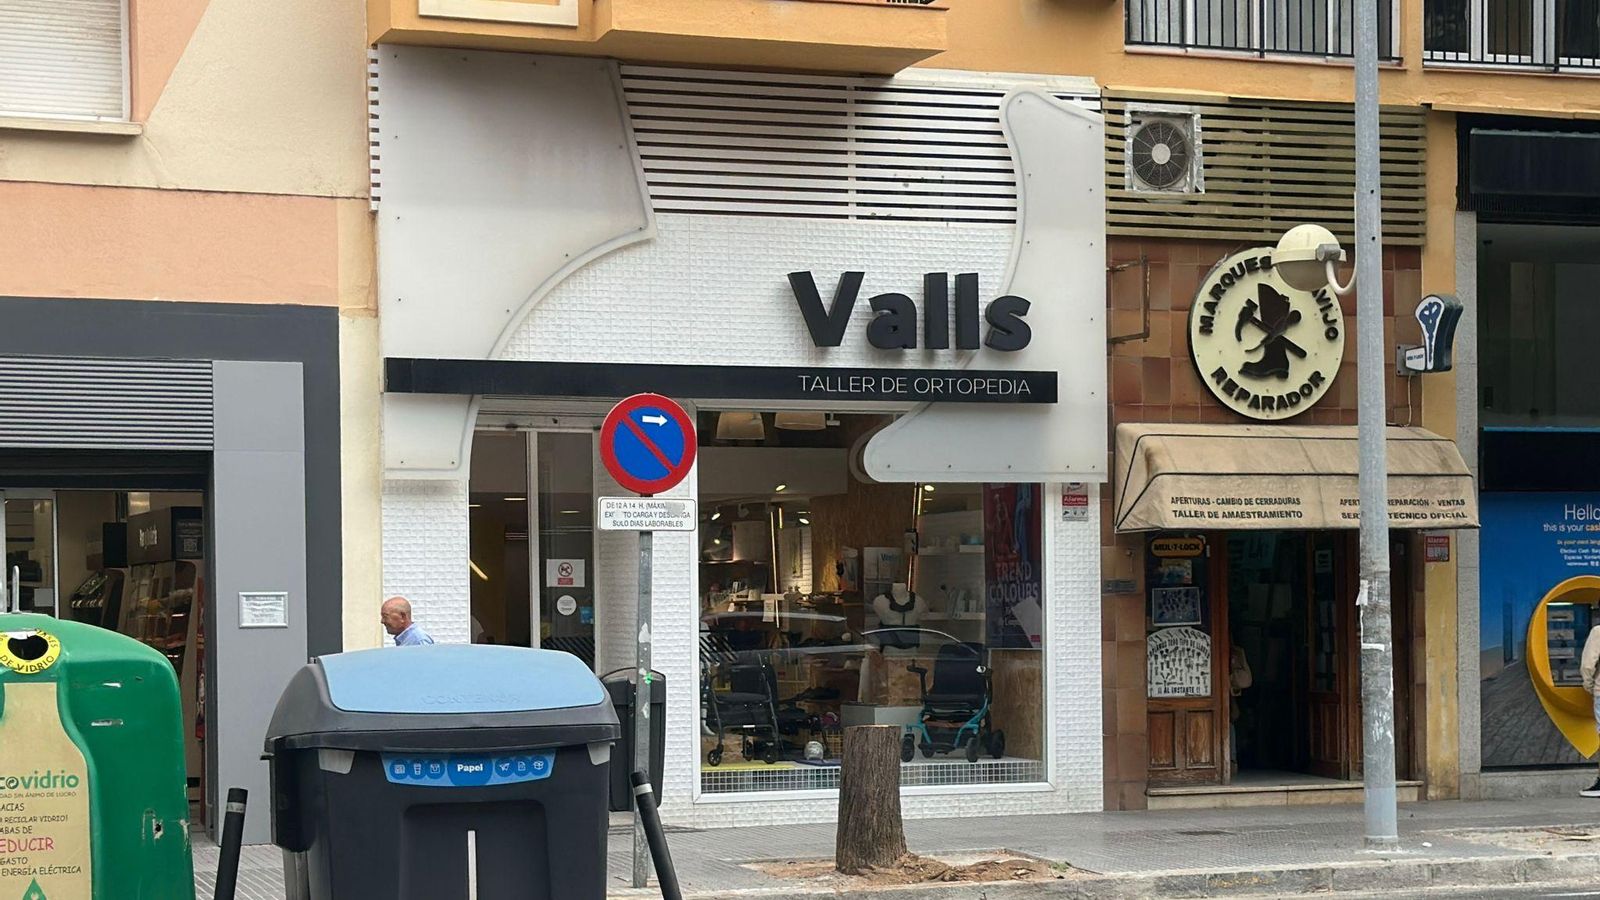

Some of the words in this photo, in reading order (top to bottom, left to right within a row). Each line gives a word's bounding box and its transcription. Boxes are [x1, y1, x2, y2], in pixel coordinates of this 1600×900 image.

[1199, 256, 1273, 336] MARQUES
[1312, 289, 1339, 341] VIJO
[787, 271, 1032, 352] Valls
[798, 375, 876, 393] TALLER
[881, 377, 908, 394] DE
[914, 377, 1031, 395] ORTOPEDIA
[1210, 366, 1325, 412] REPARADOR
[1171, 497, 1211, 505] APERTURAS
[1216, 497, 1242, 505] CAMBIO
[1255, 497, 1301, 505] CERRADURAS
[1172, 510, 1206, 518] TALLER
[1222, 510, 1303, 518] AMAESTRAMIENTO
[1543, 523, 1557, 532] this
[1558, 523, 1566, 532] is
[1567, 524, 1584, 533] your
[995, 562, 1032, 582] TREND
[989, 583, 1039, 603] COLOURS
[17, 655, 55, 672] VIDRIO
[457, 764, 483, 773] Papel
[39, 814, 68, 823] VIDRIO!
[22, 825, 33, 834] DE
[1, 865, 37, 876] ENERGÍA
[40, 864, 81, 875] ELÉCTRICA
